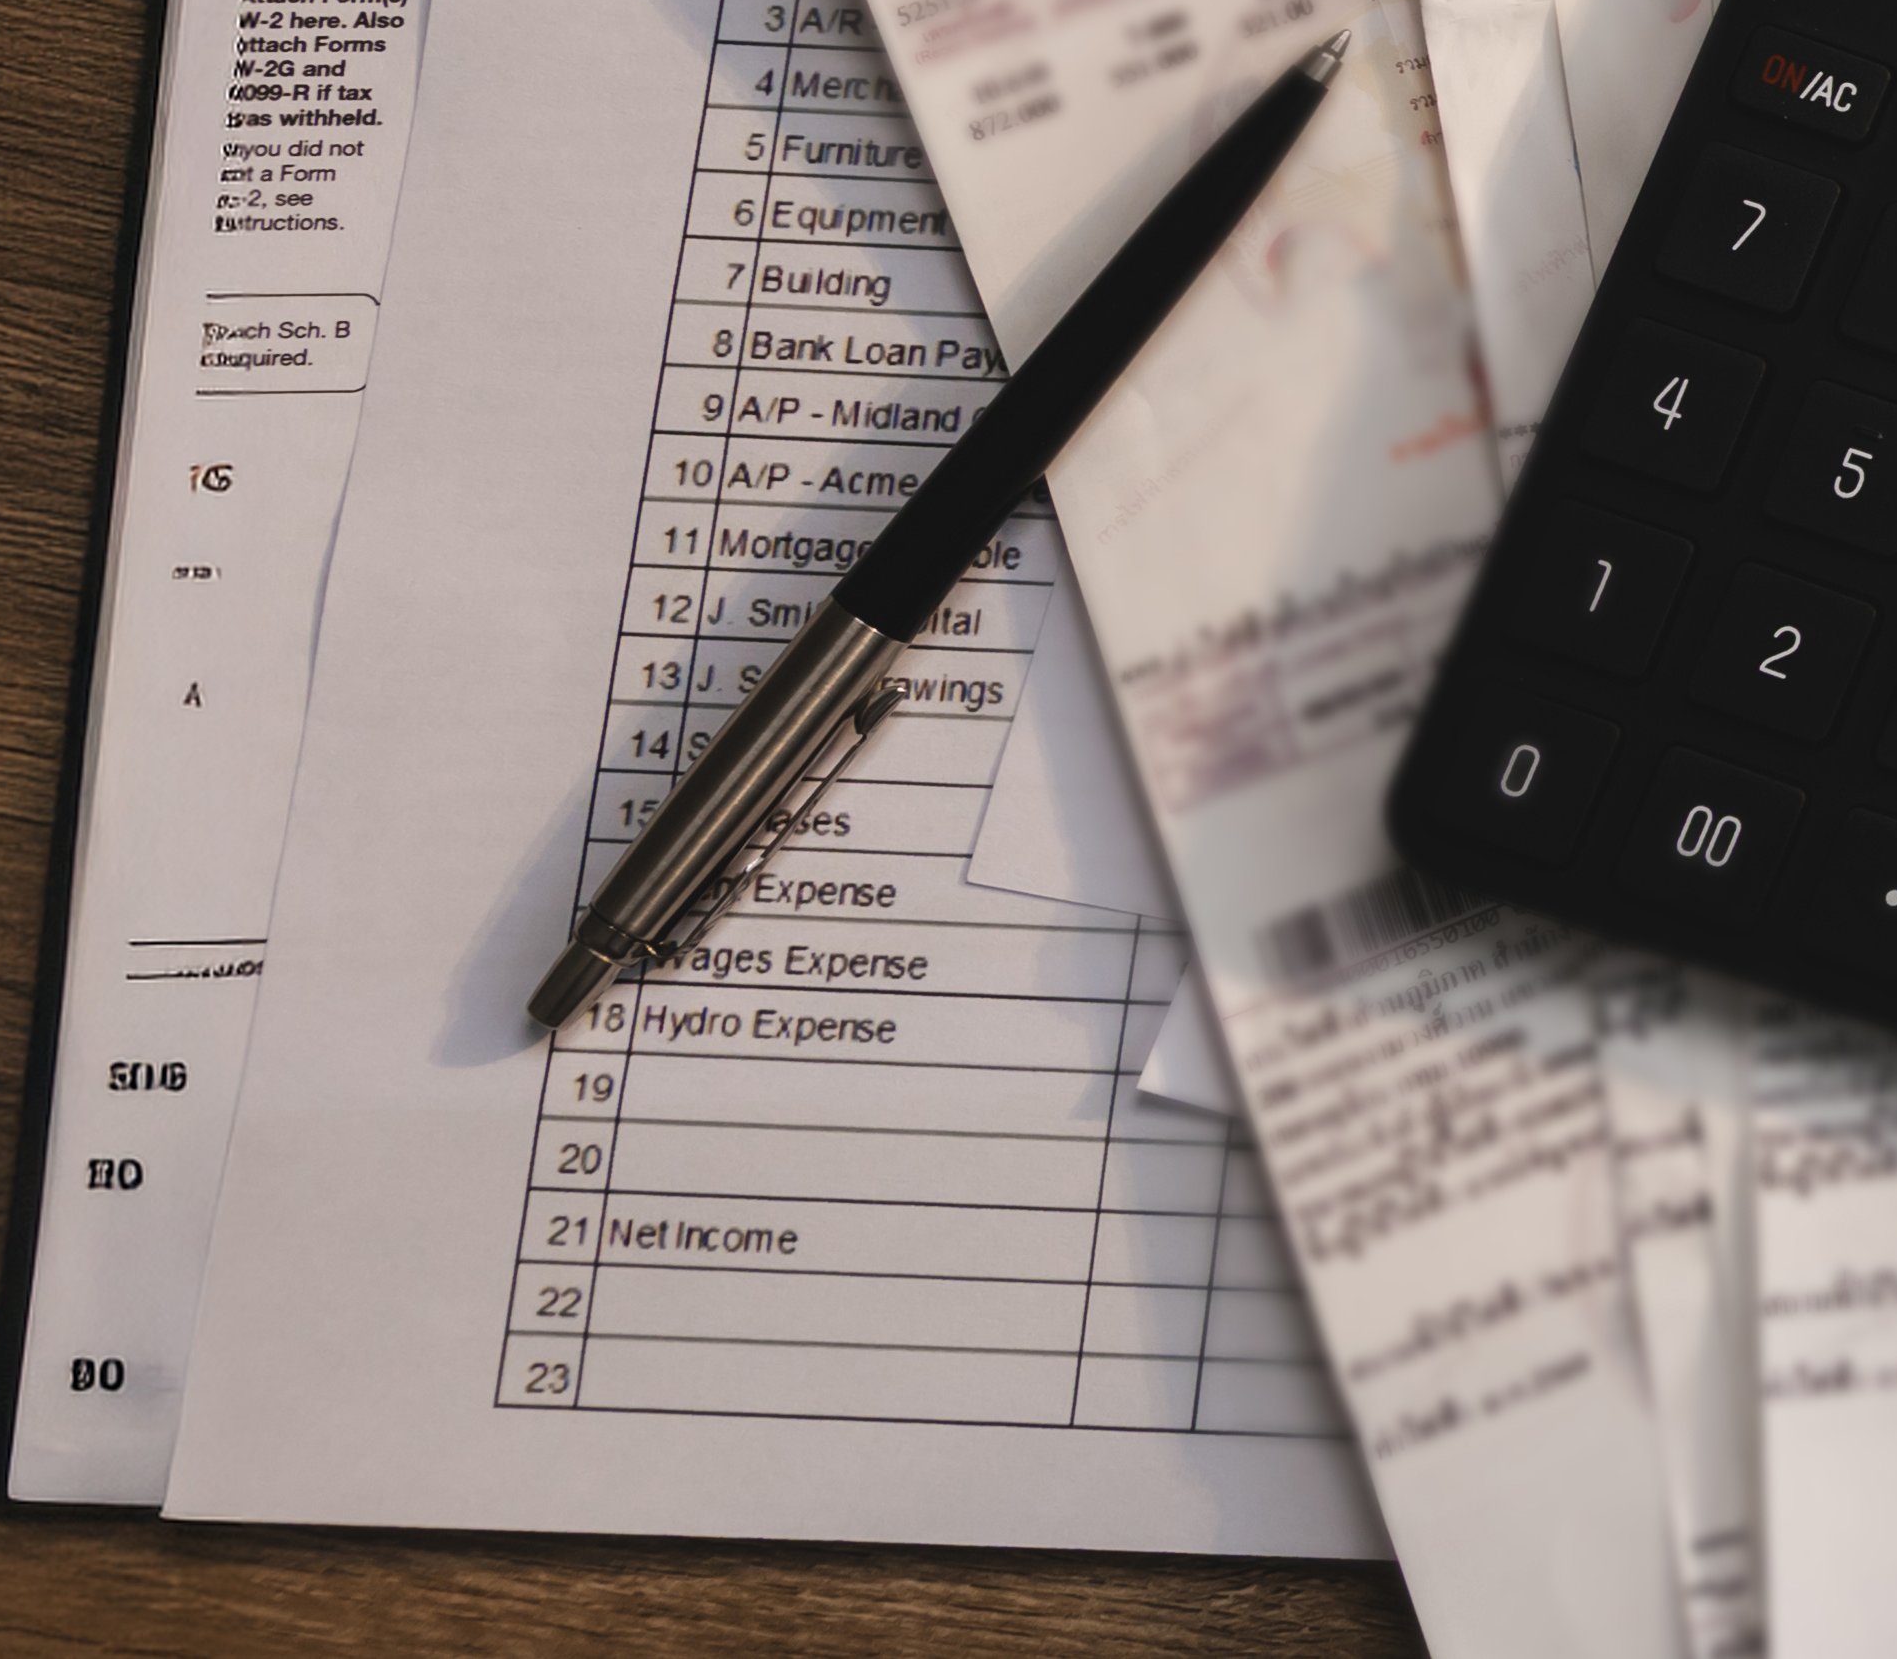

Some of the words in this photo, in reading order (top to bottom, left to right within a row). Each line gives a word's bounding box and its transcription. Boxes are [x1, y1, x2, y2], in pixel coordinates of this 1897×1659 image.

[1761, 53, 1858, 113] ON/AC
[746, 133, 766, 161] 5
[782, 134, 922, 170] Furniture
[1732, 199, 1766, 251] 7
[727, 263, 746, 289] 7
[761, 265, 892, 306] Building
[1653, 377, 1689, 430] 4
[1834, 447, 1873, 499] 5
[1589, 559, 1612, 612] 1
[1759, 625, 1801, 679] 2
[1500, 744, 1541, 797] 0
[1676, 805, 1742, 867] 00
[586, 1003, 626, 1034] 18
[643, 1005, 742, 1042] Hydro
[752, 1009, 897, 1047] Expense
[575, 1073, 614, 1102] 19
[558, 1143, 602, 1175] 20
[547, 1215, 588, 1246] 21
[536, 1287, 582, 1318] 22
[525, 1362, 570, 1394] 23
